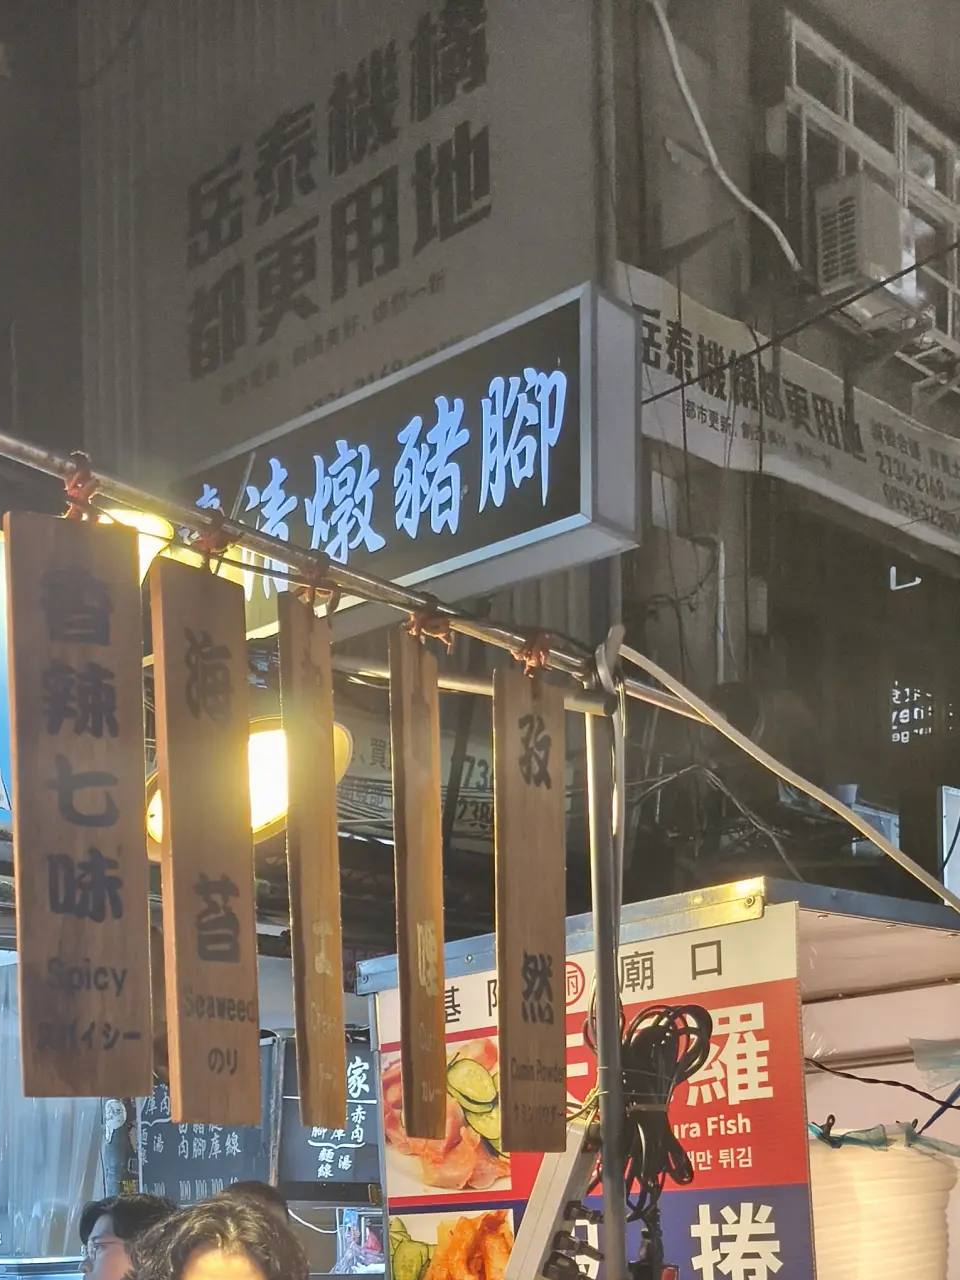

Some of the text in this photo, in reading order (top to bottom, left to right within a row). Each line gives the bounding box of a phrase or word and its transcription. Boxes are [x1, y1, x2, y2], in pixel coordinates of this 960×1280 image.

[187, 120, 493, 383] 都更用地
[184, 625, 241, 964] 海苔
[518, 713, 555, 1026] 孜然
[618, 939, 723, 995] 廟口
[346, 1055, 370, 1099] 家
[706, 1113, 751, 1137] Fish
[718, 1146, 753, 1169] 튀김
